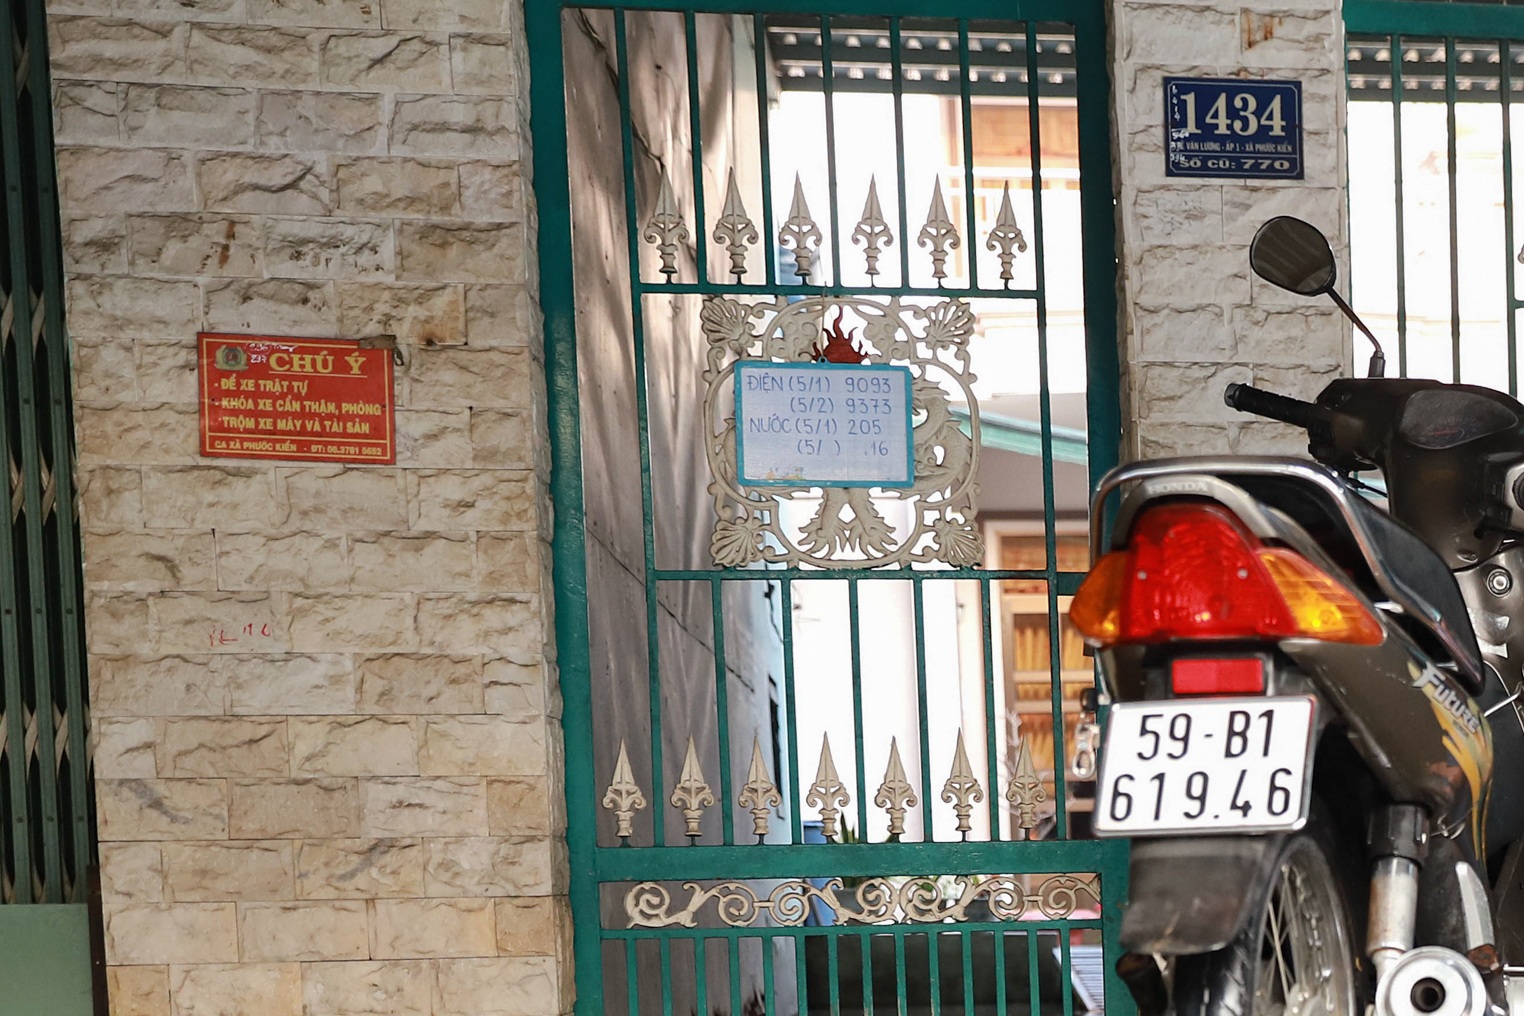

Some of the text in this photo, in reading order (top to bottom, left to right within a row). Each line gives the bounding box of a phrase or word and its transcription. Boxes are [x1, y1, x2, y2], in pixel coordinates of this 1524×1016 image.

[1180, 92, 1287, 136] 1434
[1207, 157, 1236, 169] CŨ:
[1240, 158, 1290, 170] 770
[269, 350, 366, 374] CHÚ Ý
[240, 379, 255, 391] XE
[258, 378, 289, 395] TRẬT
[292, 380, 308, 396] TỰ
[746, 372, 892, 394] ĐIỆN (5/1) 9093
[222, 394, 382, 416] KHÓA XE CẨN THẬN, PHÒNG
[790, 396, 892, 415] (5/2) 9373
[222, 415, 370, 433] TRỘM XE MÁY VÀ TÀI SẢN
[750, 412, 882, 435] NƯỚC (5/1) 205
[214, 440, 227, 449] CA
[1136, 709, 1275, 761] 59-B1
[1109, 768, 1293, 823] 619.46
